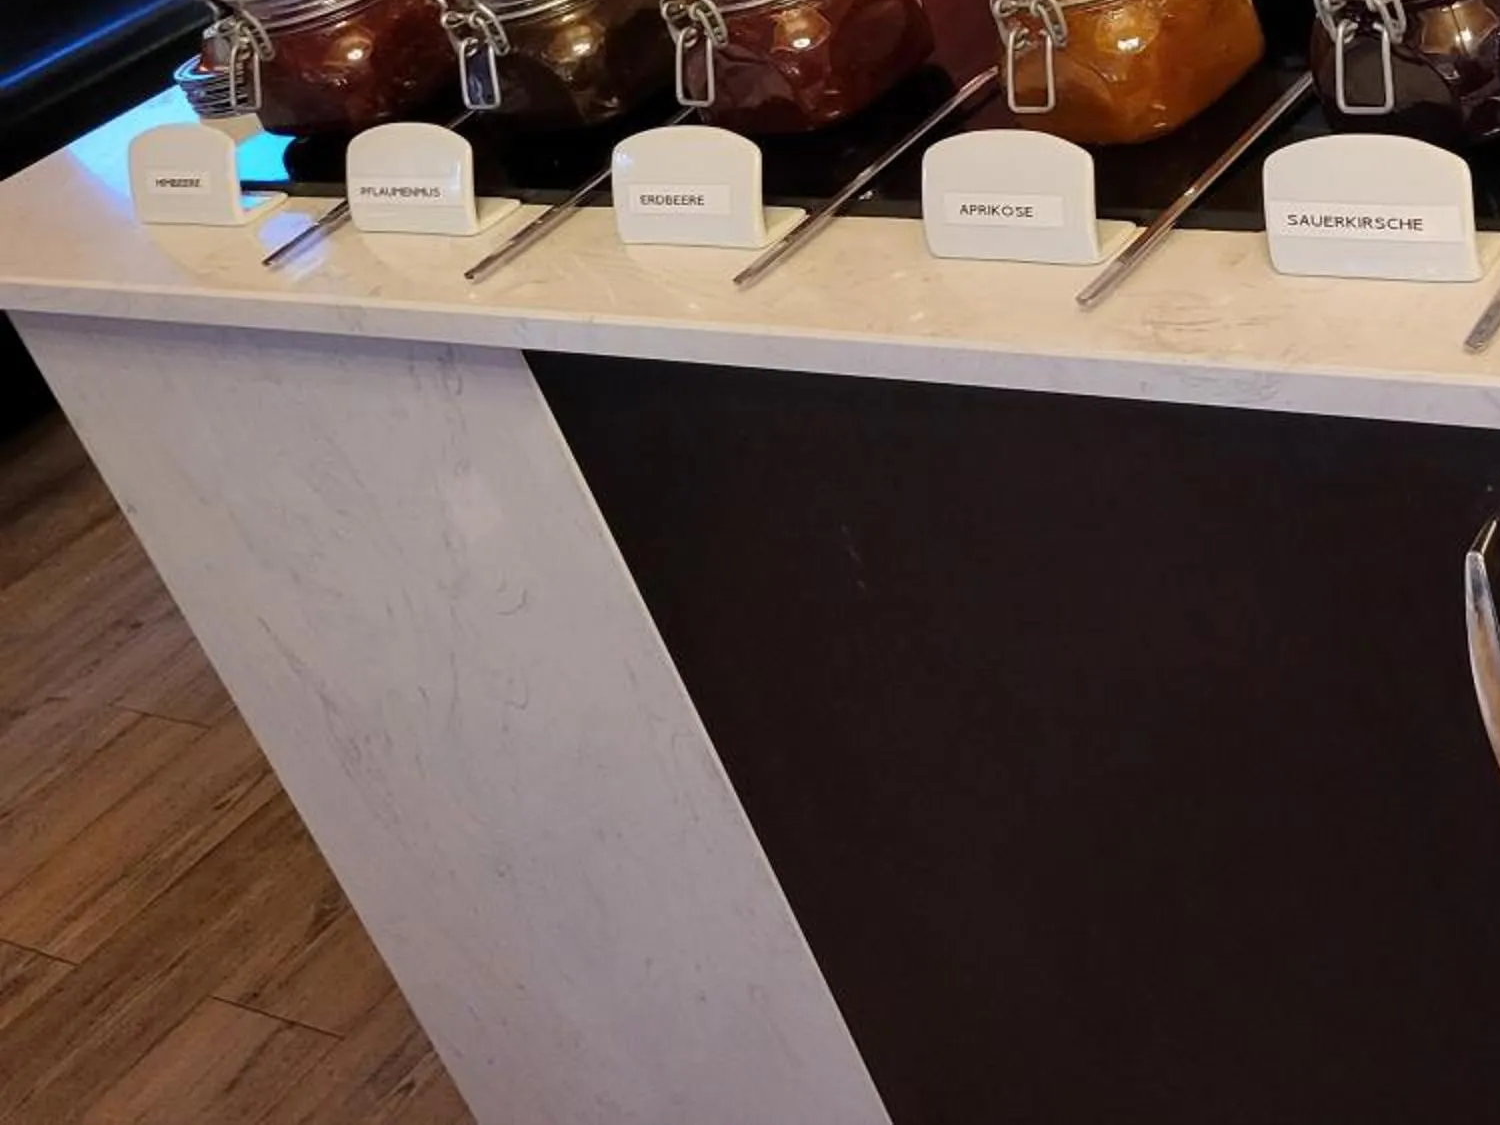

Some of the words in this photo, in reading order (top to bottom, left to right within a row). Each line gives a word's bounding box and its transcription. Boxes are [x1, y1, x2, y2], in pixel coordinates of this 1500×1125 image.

[360, 186, 441, 198] PFLAUMENMUS
[640, 194, 705, 206] ERDBEERE
[959, 204, 1034, 218] APRIKOSE
[1287, 214, 1424, 232] SAUERKIRSCHE
